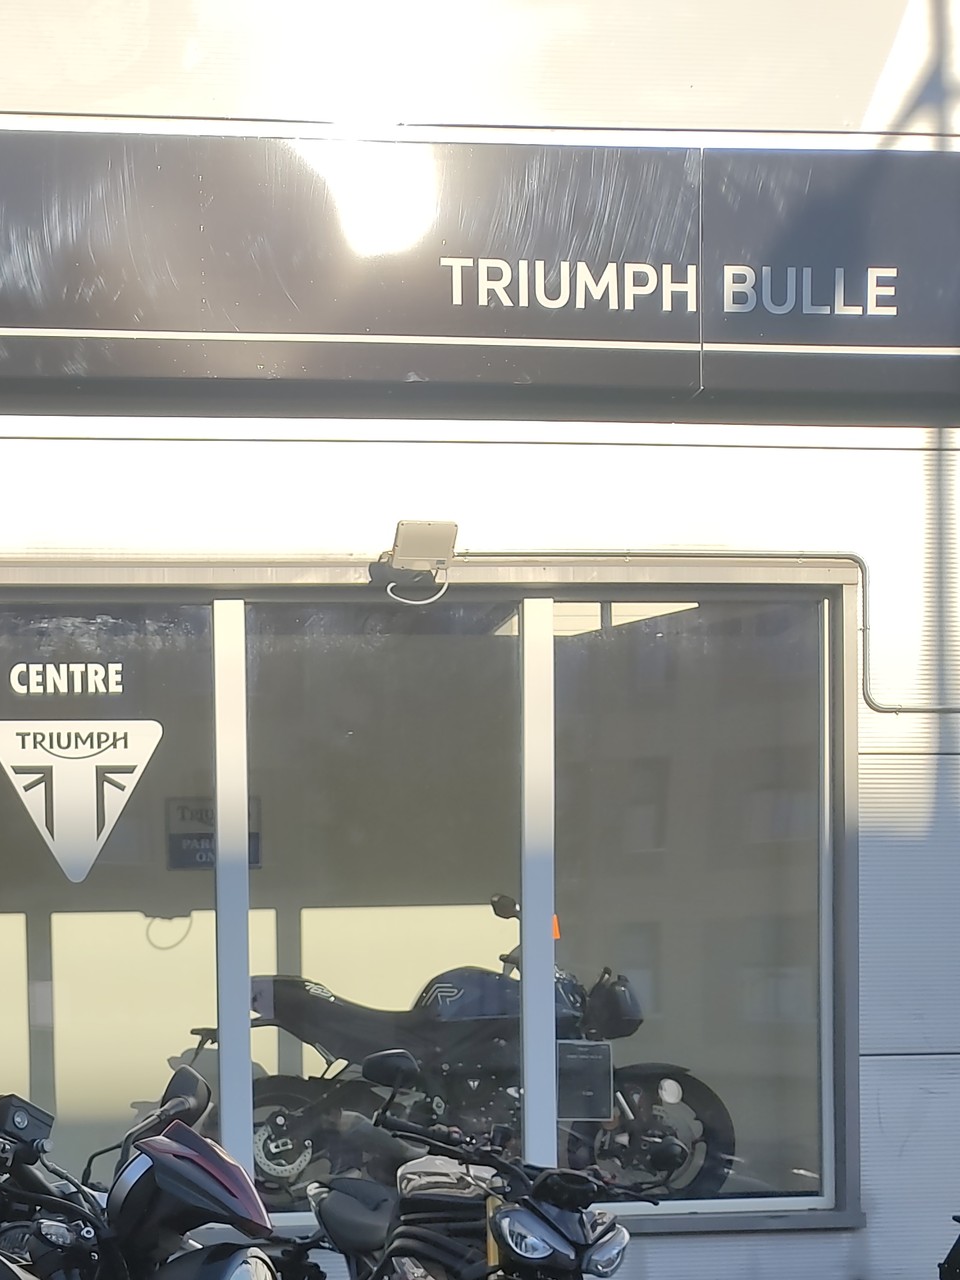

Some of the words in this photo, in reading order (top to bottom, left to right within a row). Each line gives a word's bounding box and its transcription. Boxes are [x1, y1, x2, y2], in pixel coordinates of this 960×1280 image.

[439, 257, 697, 312] TRIUMPH
[723, 264, 898, 316] BULLE
[9, 662, 124, 695] CENTRE
[15, 731, 129, 754] TRIUMPH
